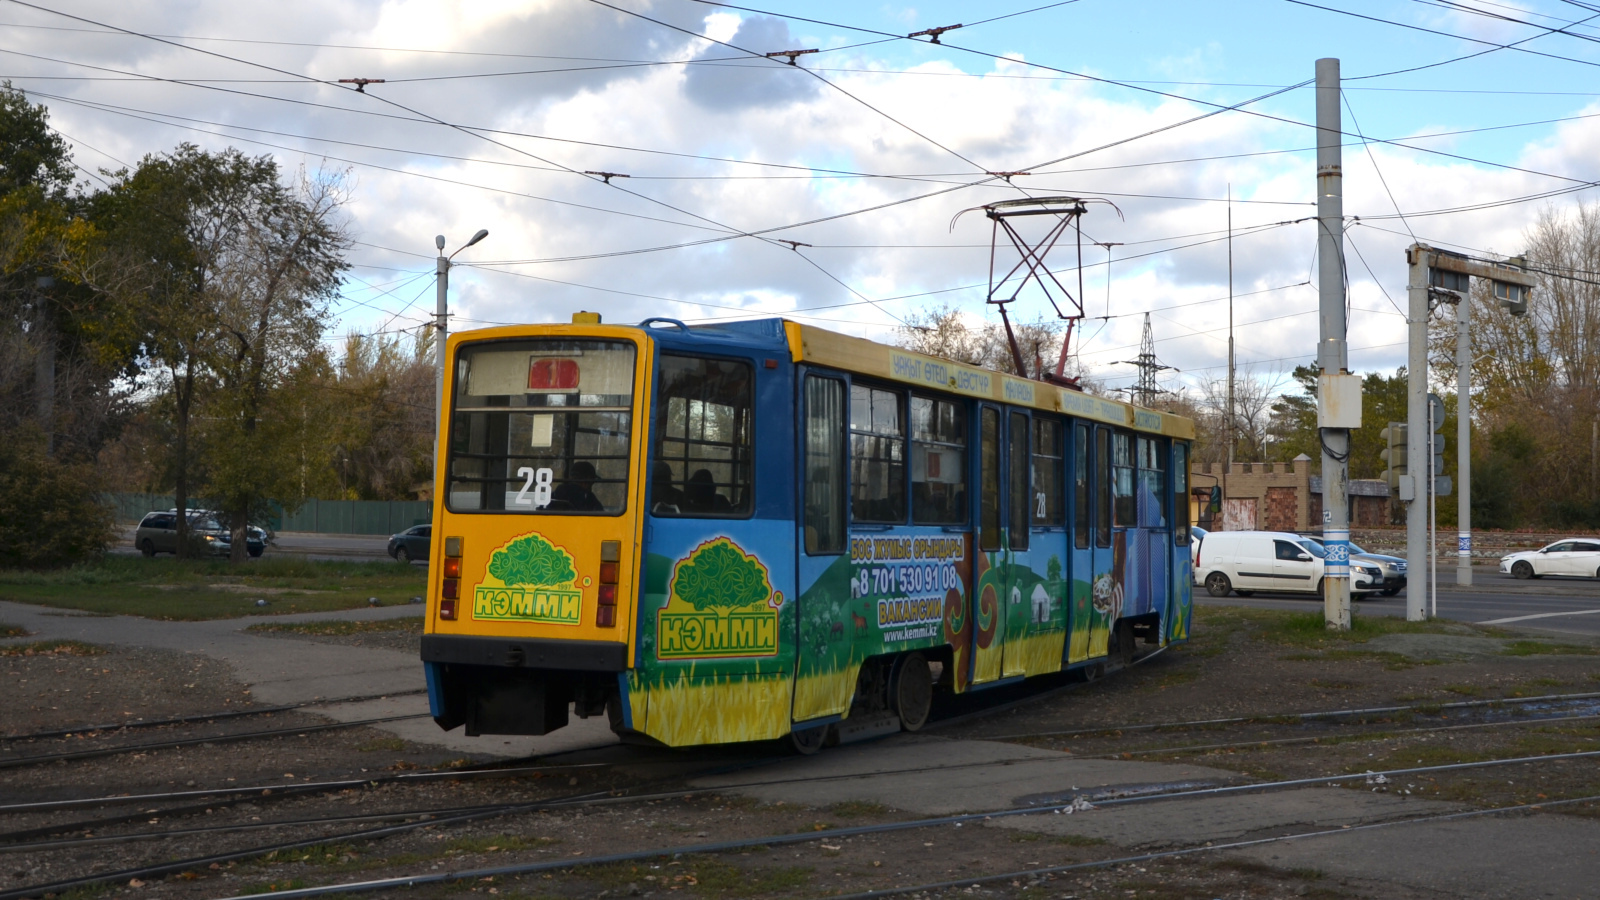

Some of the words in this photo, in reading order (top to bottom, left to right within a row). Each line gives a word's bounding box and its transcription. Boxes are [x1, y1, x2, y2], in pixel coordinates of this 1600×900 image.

[515, 466, 553, 506] 28
[1036, 492, 1046, 518] 28
[850, 537, 872, 561] БОС
[913, 537, 963, 562] ОРЫНДАРЫ
[557, 583, 572, 591] 1997
[860, 568, 869, 595] 8
[872, 567, 896, 594] 701
[899, 566, 922, 593] 530
[925, 565, 939, 591] 91
[942, 565, 957, 590] 08
[474, 589, 581, 620] КЭММИ
[751, 603, 766, 612] 1997
[879, 597, 942, 625] ВАКАНСИИ
[660, 616, 776, 651] КЭММИ
[883, 624, 938, 643] www.kemmi.kz
